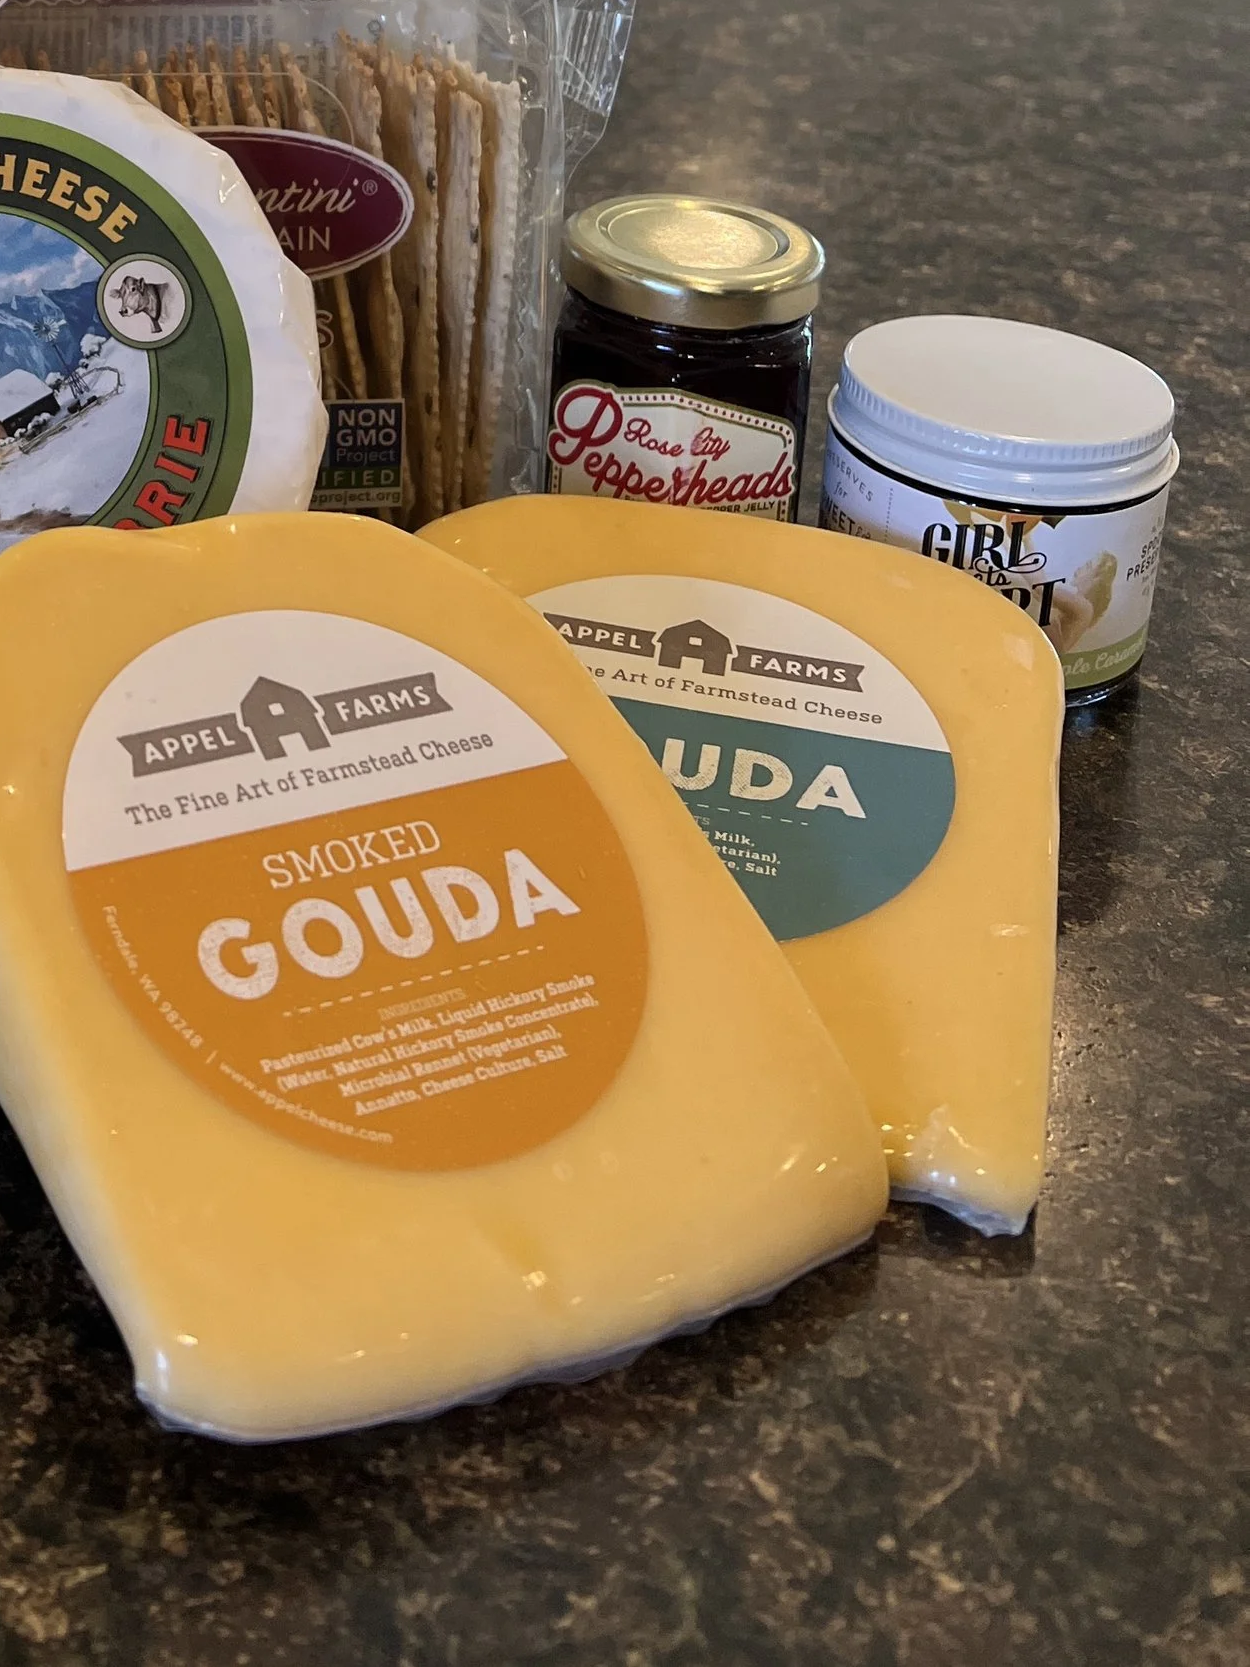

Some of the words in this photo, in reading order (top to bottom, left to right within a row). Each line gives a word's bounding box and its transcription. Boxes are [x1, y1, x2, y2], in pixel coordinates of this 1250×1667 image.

[336, 427, 398, 447] GMO
[337, 408, 397, 428] NON
[623, 417, 685, 457] Rose
[689, 426, 732, 462] City
[336, 447, 397, 467] Project
[743, 500, 777, 513] JELLY
[921, 520, 1048, 574] GIRL
[558, 621, 643, 650] APPEL
[749, 654, 848, 684] FARMS
[142, 724, 237, 764] APPEL
[334, 684, 432, 723] FARMS
[611, 666, 649, 687] Art
[654, 673, 676, 690] of
[681, 680, 798, 711] Farmstead
[803, 700, 883, 725] Cheese
[125, 802, 173, 827] The
[175, 786, 230, 816] Fine
[236, 778, 275, 804] Art
[276, 770, 301, 793] of
[301, 743, 418, 790] Farmstead
[419, 730, 495, 762] Cheese
[661, 737, 867, 820] UDA
[261, 819, 442, 890] SMOKED
[745, 861, 778, 877] Salt
[196, 847, 582, 1002] GOUDA
[138, 973, 162, 1004] WA
[157, 1000, 205, 1049] 98248
[259, 1038, 352, 1074] Pasteurized
[437, 1001, 487, 1027] Liquid
[487, 985, 547, 1014] Hickory
[546, 973, 596, 995] Smoke
[333, 1048, 392, 1077] Natural
[393, 1033, 455, 1060] Hickory
[455, 1019, 504, 1042] Smoke
[338, 1065, 414, 1097] Microbial
[414, 1050, 468, 1077] Rennet
[421, 1071, 475, 1098] Cheese
[535, 1043, 569, 1064] Salt
